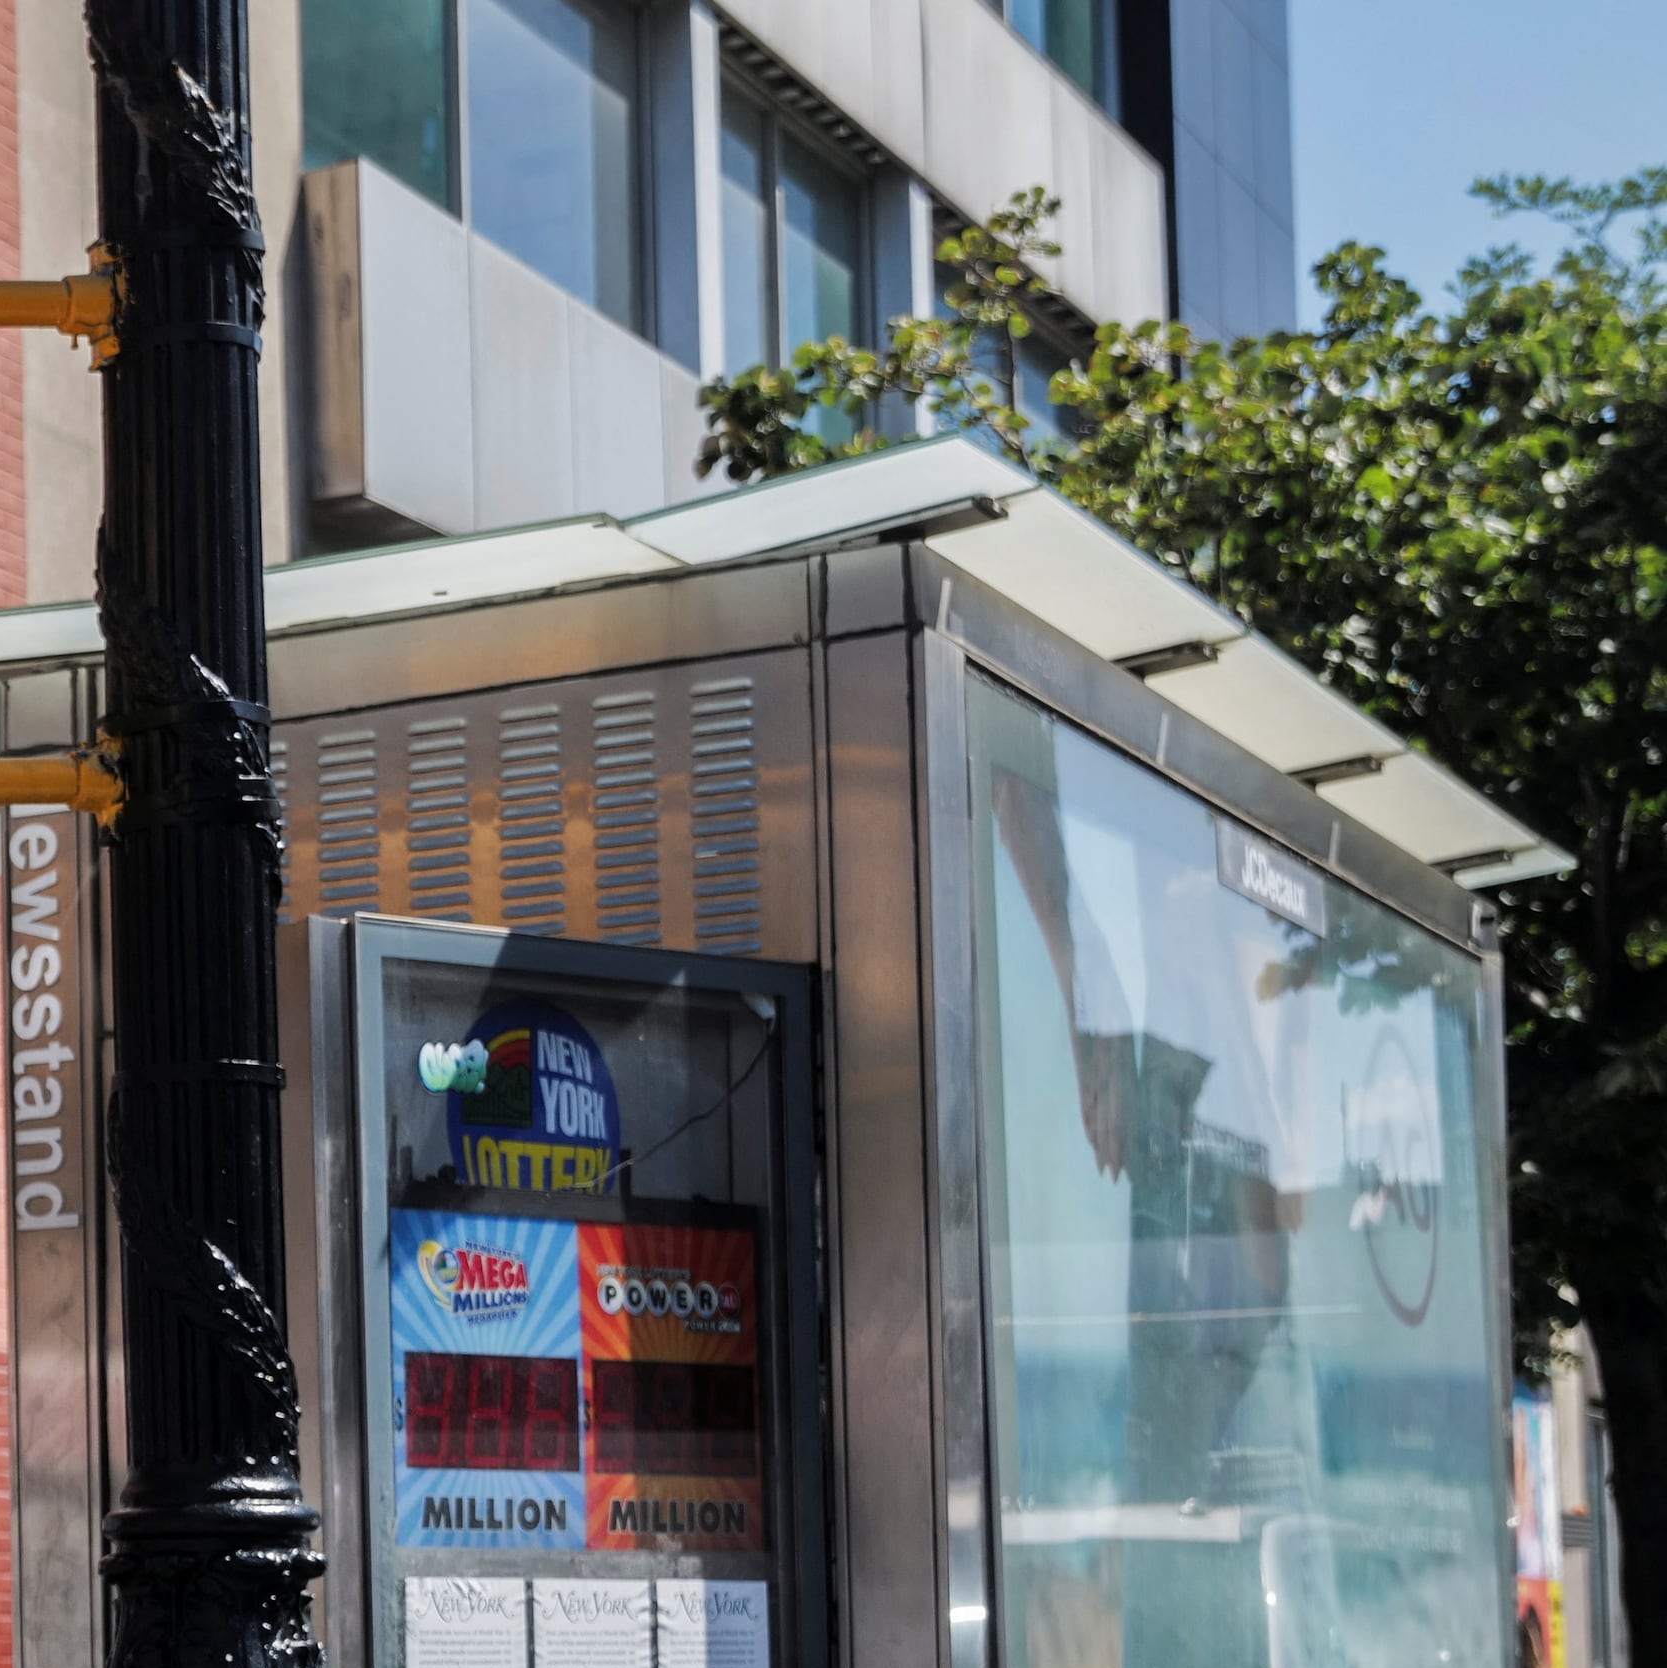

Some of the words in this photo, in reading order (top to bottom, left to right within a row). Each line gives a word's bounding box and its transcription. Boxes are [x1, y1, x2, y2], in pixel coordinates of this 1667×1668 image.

[1242, 844, 1306, 919] JCDecaux
[9, 803, 80, 1231] ewsstand
[537, 1032, 592, 1084] NEW
[540, 1077, 607, 1139] YORK
[463, 1135, 611, 1193] LOTTERY
[456, 1250, 529, 1290] MEGA
[453, 1292, 528, 1313] MILLIONS
[683, 1320, 716, 1332] POWER
[421, 1495, 568, 1532] MILLION
[609, 1499, 746, 1534] MILLION
[415, 1590, 464, 1623] NEW
[458, 1591, 515, 1623] YORK
[542, 1590, 590, 1624] NEW
[586, 1591, 639, 1624] YORK
